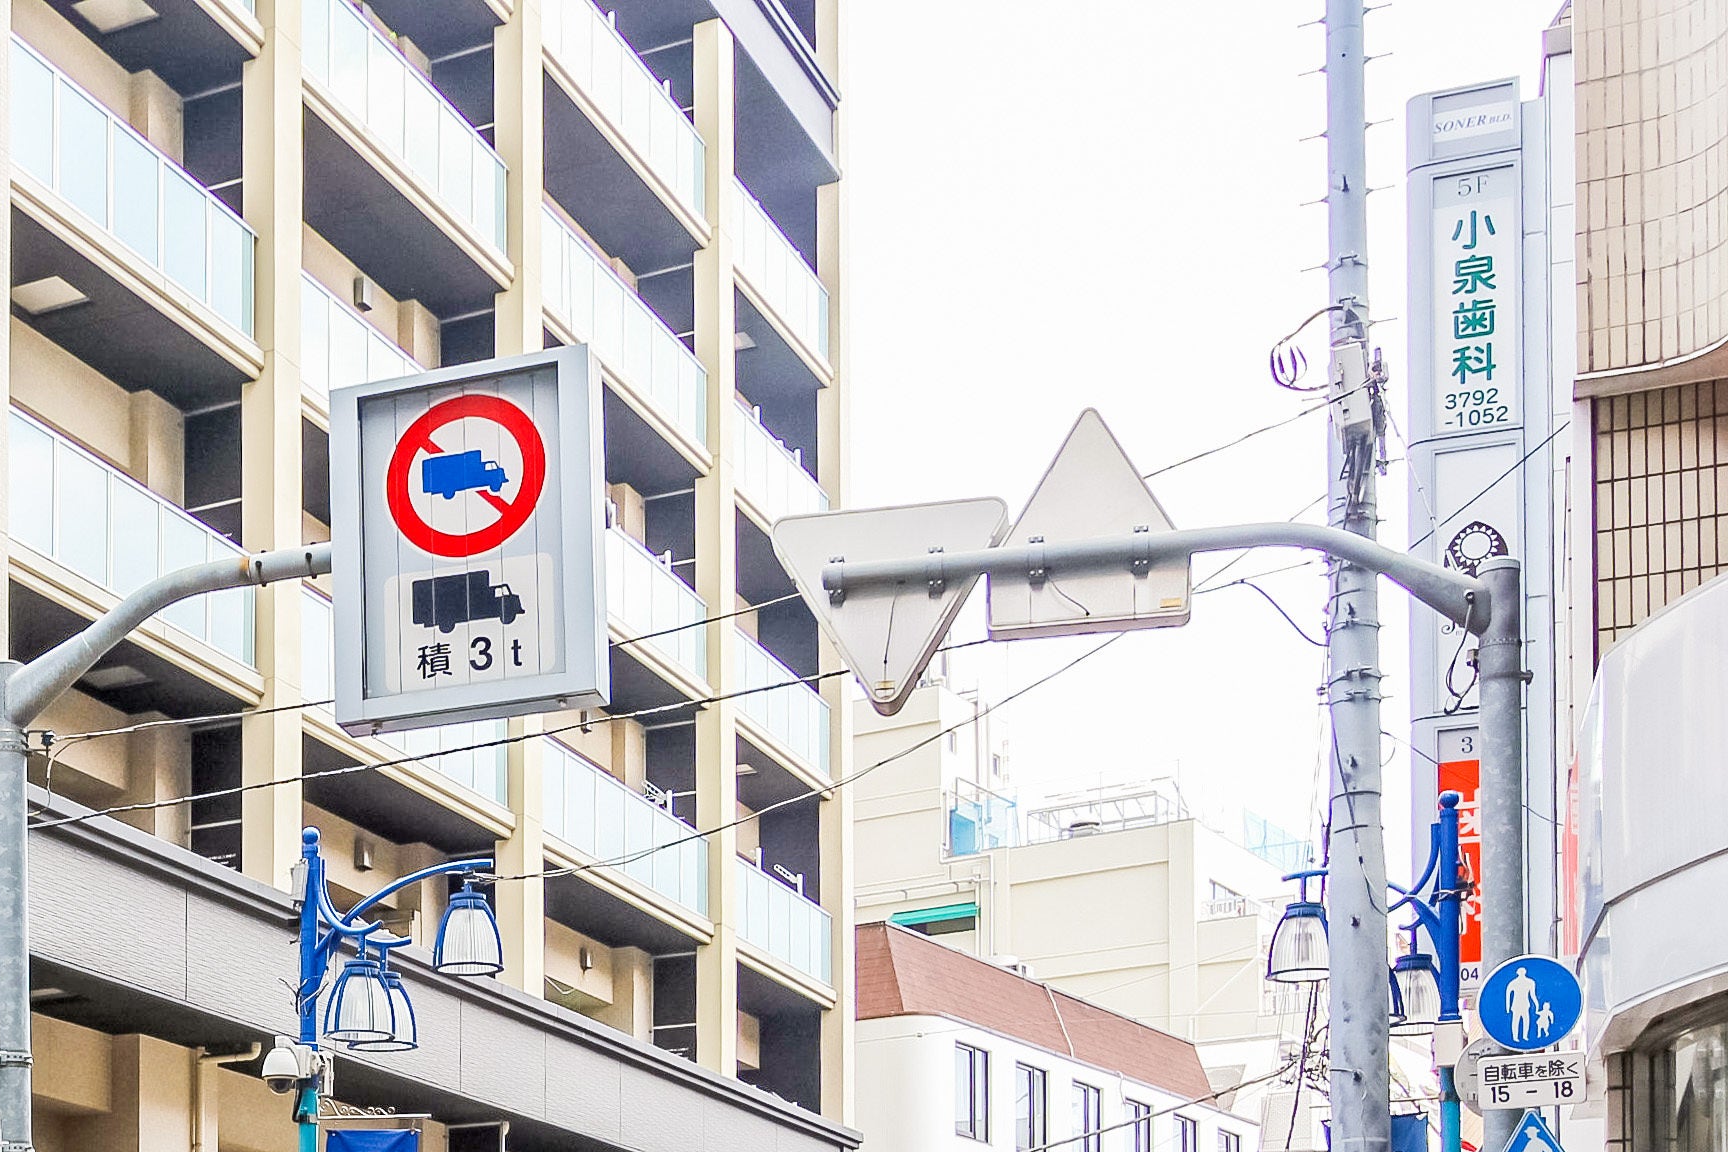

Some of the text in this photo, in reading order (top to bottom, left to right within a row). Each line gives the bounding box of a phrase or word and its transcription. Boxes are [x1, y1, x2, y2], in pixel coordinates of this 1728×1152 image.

[1433, 114, 1487, 134] SONER
[1457, 174, 1489, 197] 5F
[1452, 210, 1496, 385] 小泉歯科
[1445, 388, 1498, 409] 3792
[1445, 406, 1509, 428] -1052
[1484, 1060, 1578, 1082] 自転車を除く
[1491, 1085, 1510, 1104] 15
[1553, 1080, 1574, 1099] 18
